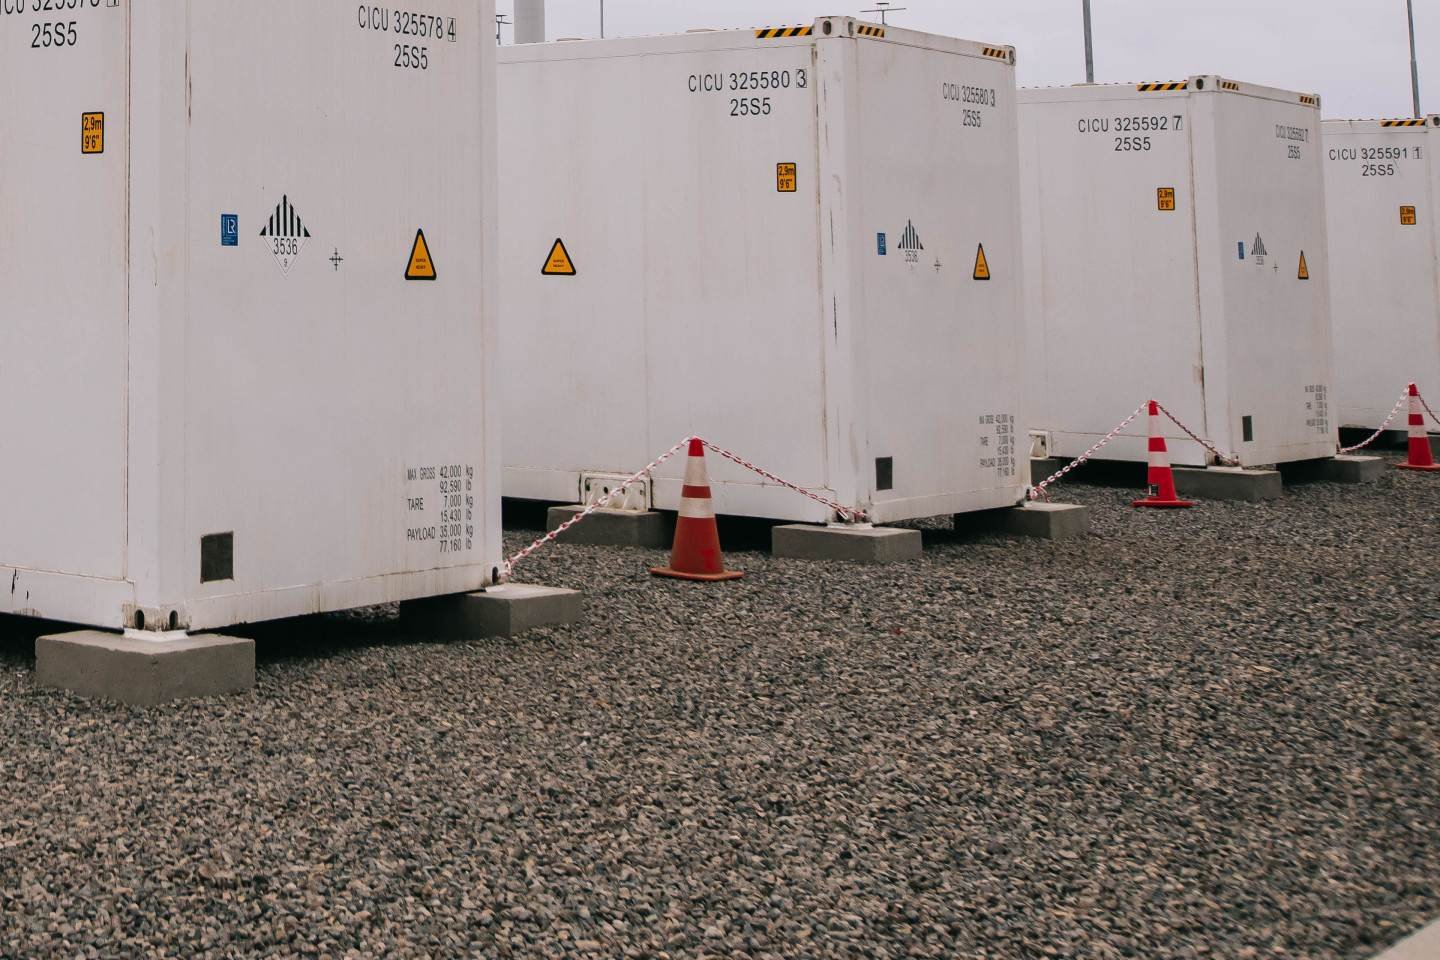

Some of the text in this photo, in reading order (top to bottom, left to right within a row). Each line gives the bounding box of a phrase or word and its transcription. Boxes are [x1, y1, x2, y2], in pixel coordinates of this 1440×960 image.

[358, 5, 456, 41] CICU 325578 4
[31, 21, 77, 48] 25S5
[394, 44, 428, 70] 25S5
[688, 69, 807, 92] CICU 325580 3
[730, 97, 771, 116] 25S5
[962, 109, 981, 127] 25S5
[1078, 115, 1182, 133] CICU 325592 7
[1114, 137, 1151, 151] 25S5
[1328, 148, 1357, 161] CICU
[1361, 147, 1407, 160] 325591
[1361, 164, 1394, 176] 25S5
[274, 238, 297, 255] 3536
[283, 258, 288, 267] 9
[407, 468, 417, 480] MAX
[420, 467, 436, 480] GROSS
[465, 464, 473, 479] kg
[465, 479, 472, 491] lb
[407, 498, 424, 511] TARE
[465, 494, 473, 508] kg
[465, 508, 472, 521] lb
[407, 527, 436, 541] PAYLOAD
[465, 523, 473, 537] kg
[465, 538, 472, 550] lb
